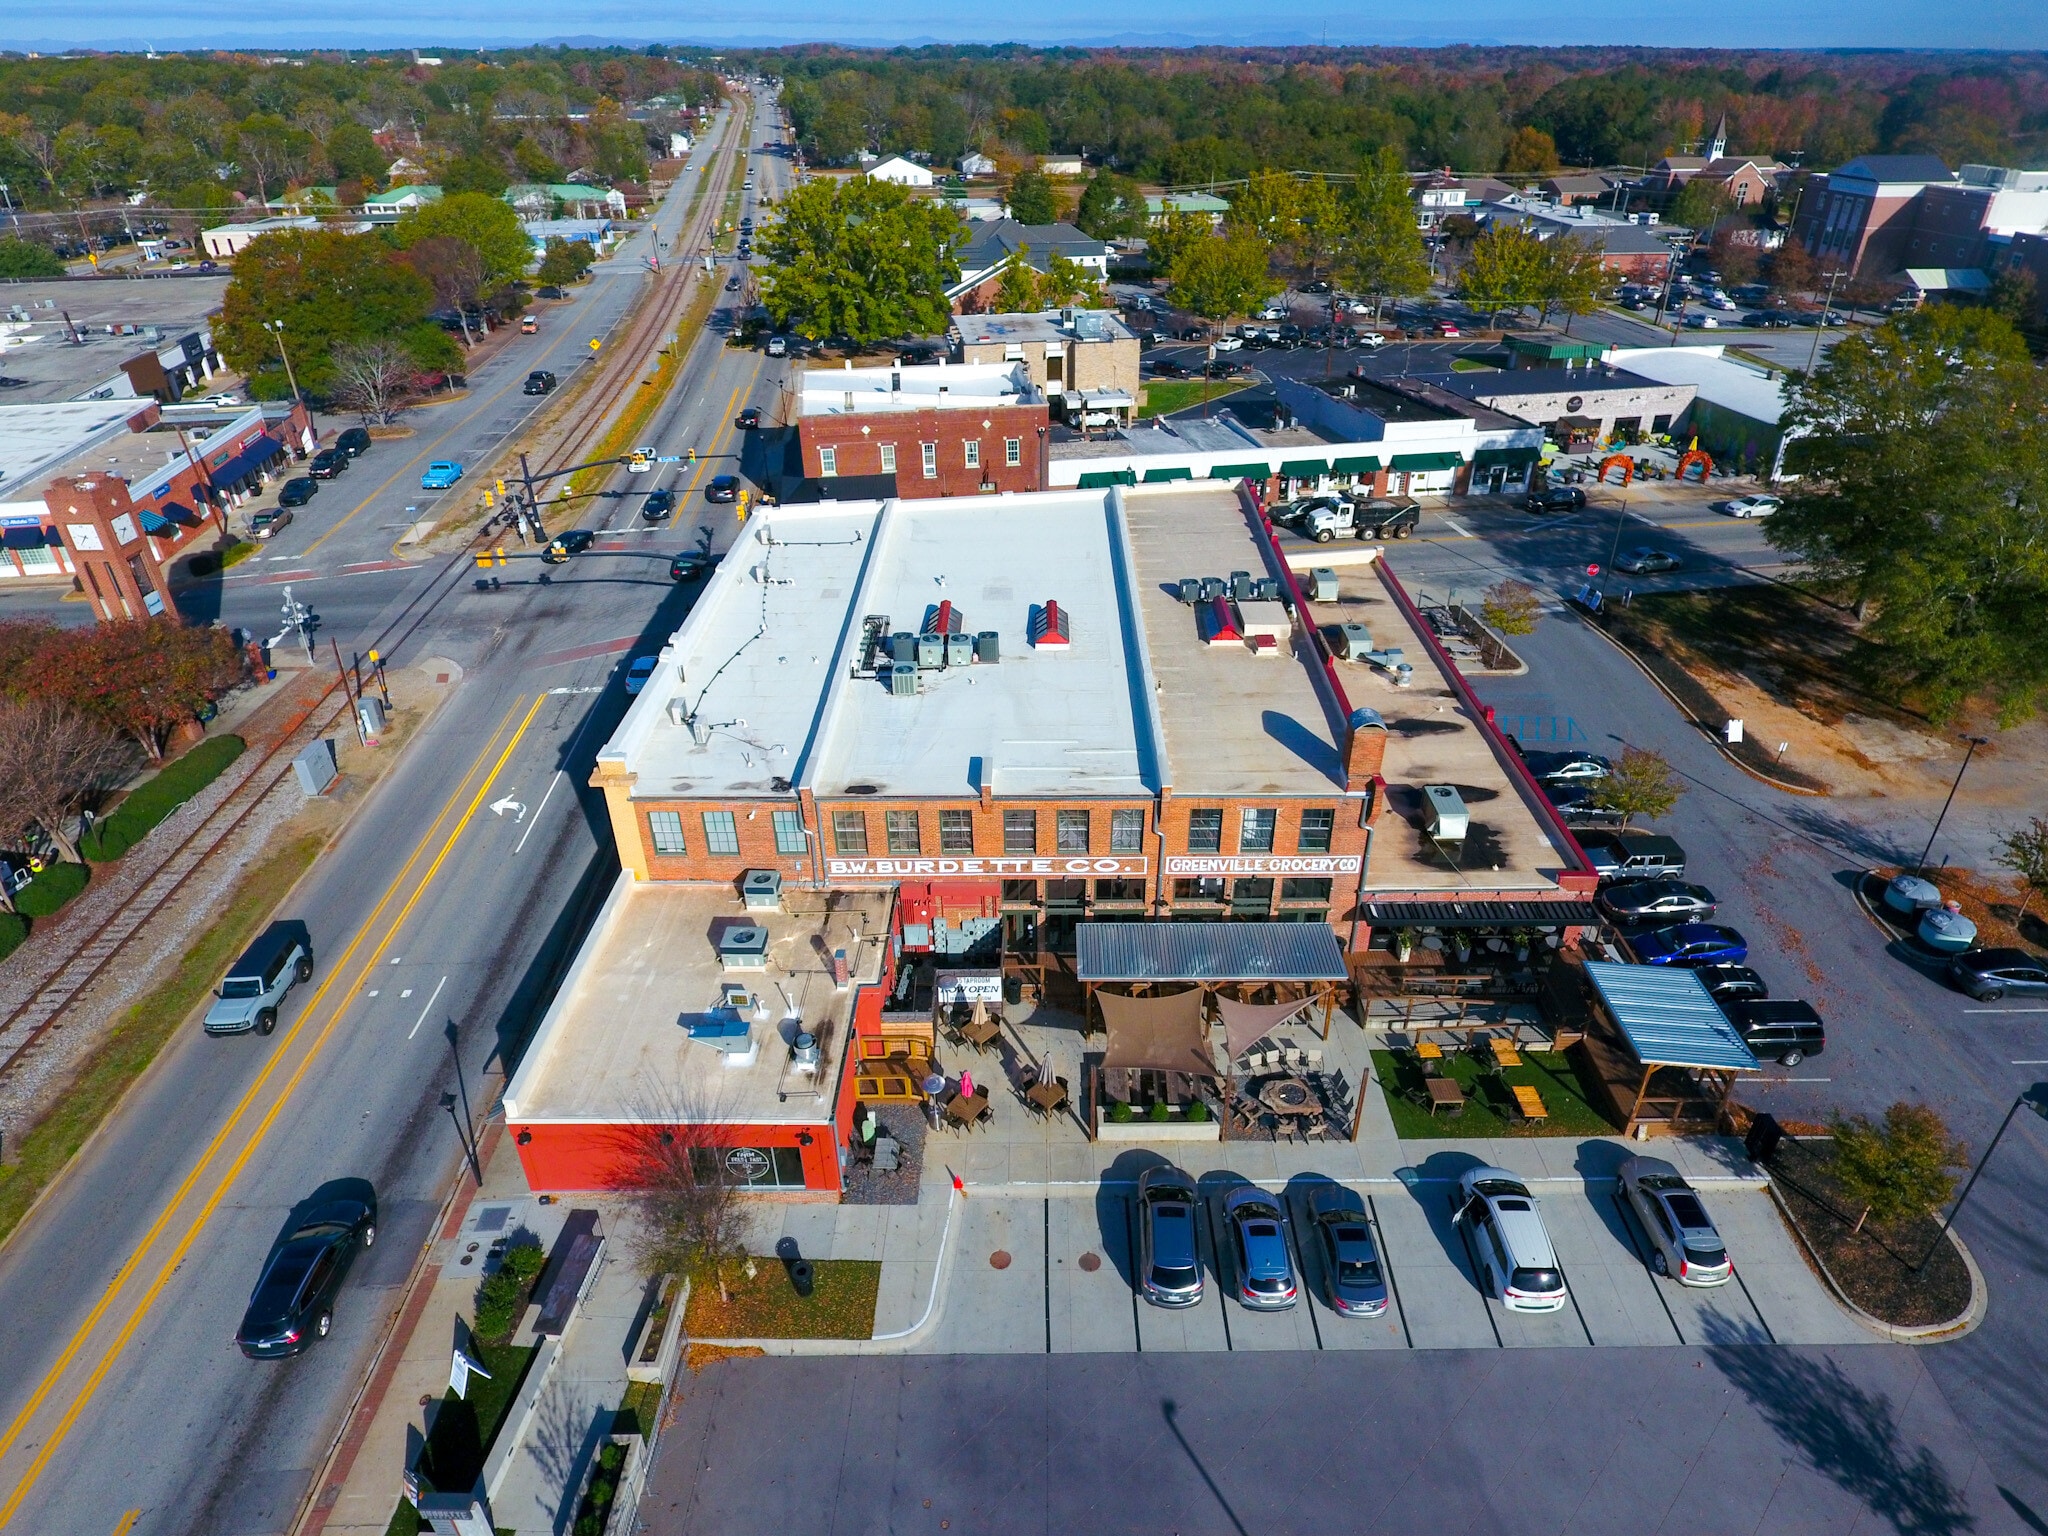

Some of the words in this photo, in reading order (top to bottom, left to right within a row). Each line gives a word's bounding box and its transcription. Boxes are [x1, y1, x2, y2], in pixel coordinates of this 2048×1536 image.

[876, 860, 1051, 873] BURDETTE
[1065, 859, 1131, 873] CO.
[1170, 859, 1262, 871] GREENVILLE
[1269, 859, 1340, 872] GROCERY
[1340, 859, 1357, 871] CO
